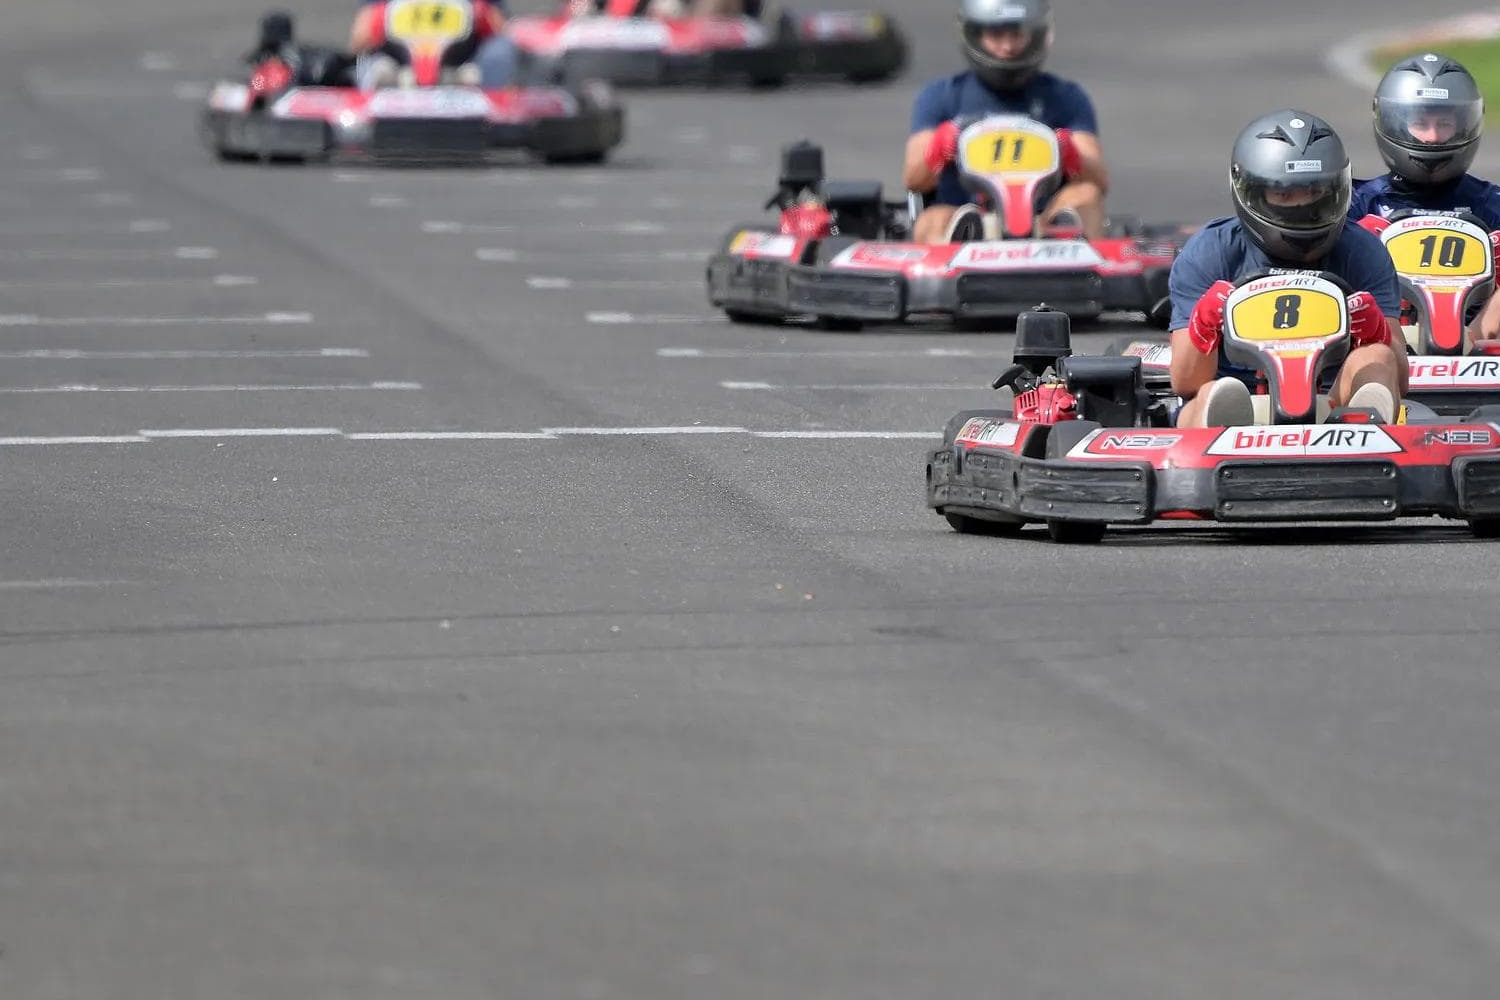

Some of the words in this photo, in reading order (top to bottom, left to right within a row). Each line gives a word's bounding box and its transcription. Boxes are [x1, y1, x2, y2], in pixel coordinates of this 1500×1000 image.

[992, 137, 1025, 163] 11
[1420, 236, 1465, 267] 10
[1248, 278, 1320, 292] birelART
[1273, 294, 1302, 329] 8
[1234, 429, 1376, 448] birelART
